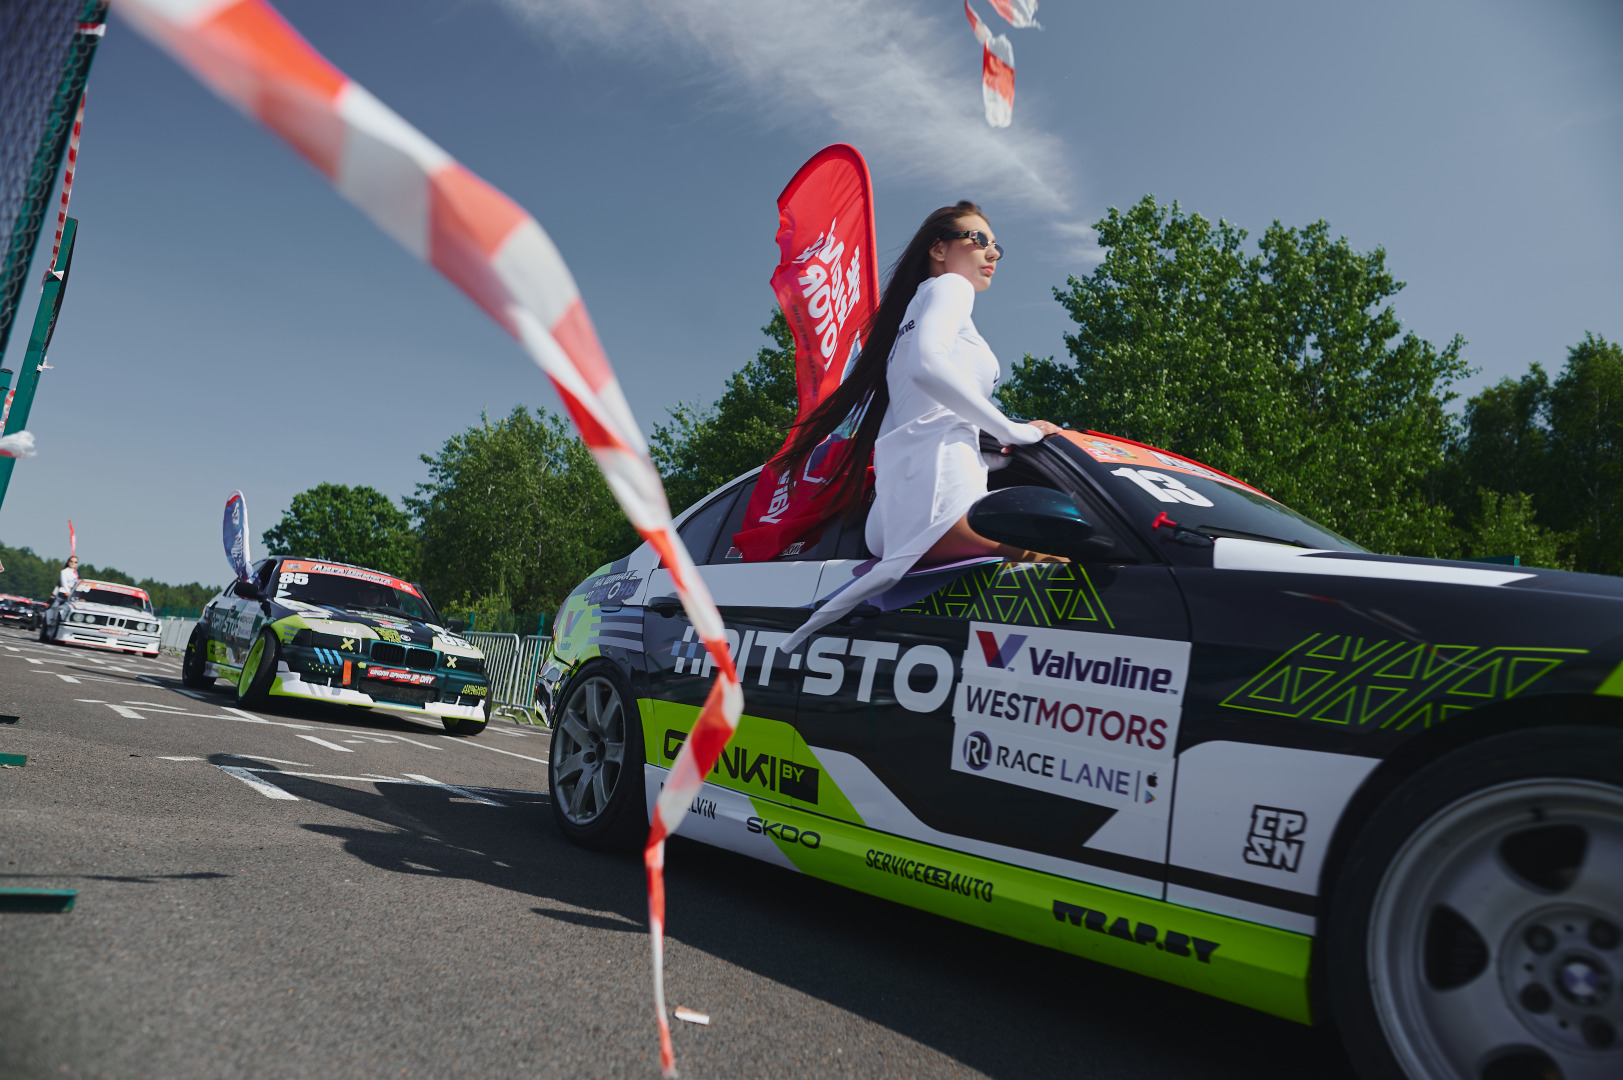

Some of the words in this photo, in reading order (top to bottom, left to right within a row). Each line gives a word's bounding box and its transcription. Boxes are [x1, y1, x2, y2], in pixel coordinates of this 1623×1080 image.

[1110, 467, 1214, 507] 13
[279, 572, 309, 585] 85
[419, 674, 435, 684] DAY
[699, 628, 954, 713] PIT-STO
[1029, 647, 1172, 694] Valvoline
[967, 685, 1168, 750] WESTMOTORS
[664, 729, 777, 791] GNKI
[783, 764, 804, 782] BY
[997, 746, 1055, 778] RACE
[1060, 759, 1130, 795] LANE
